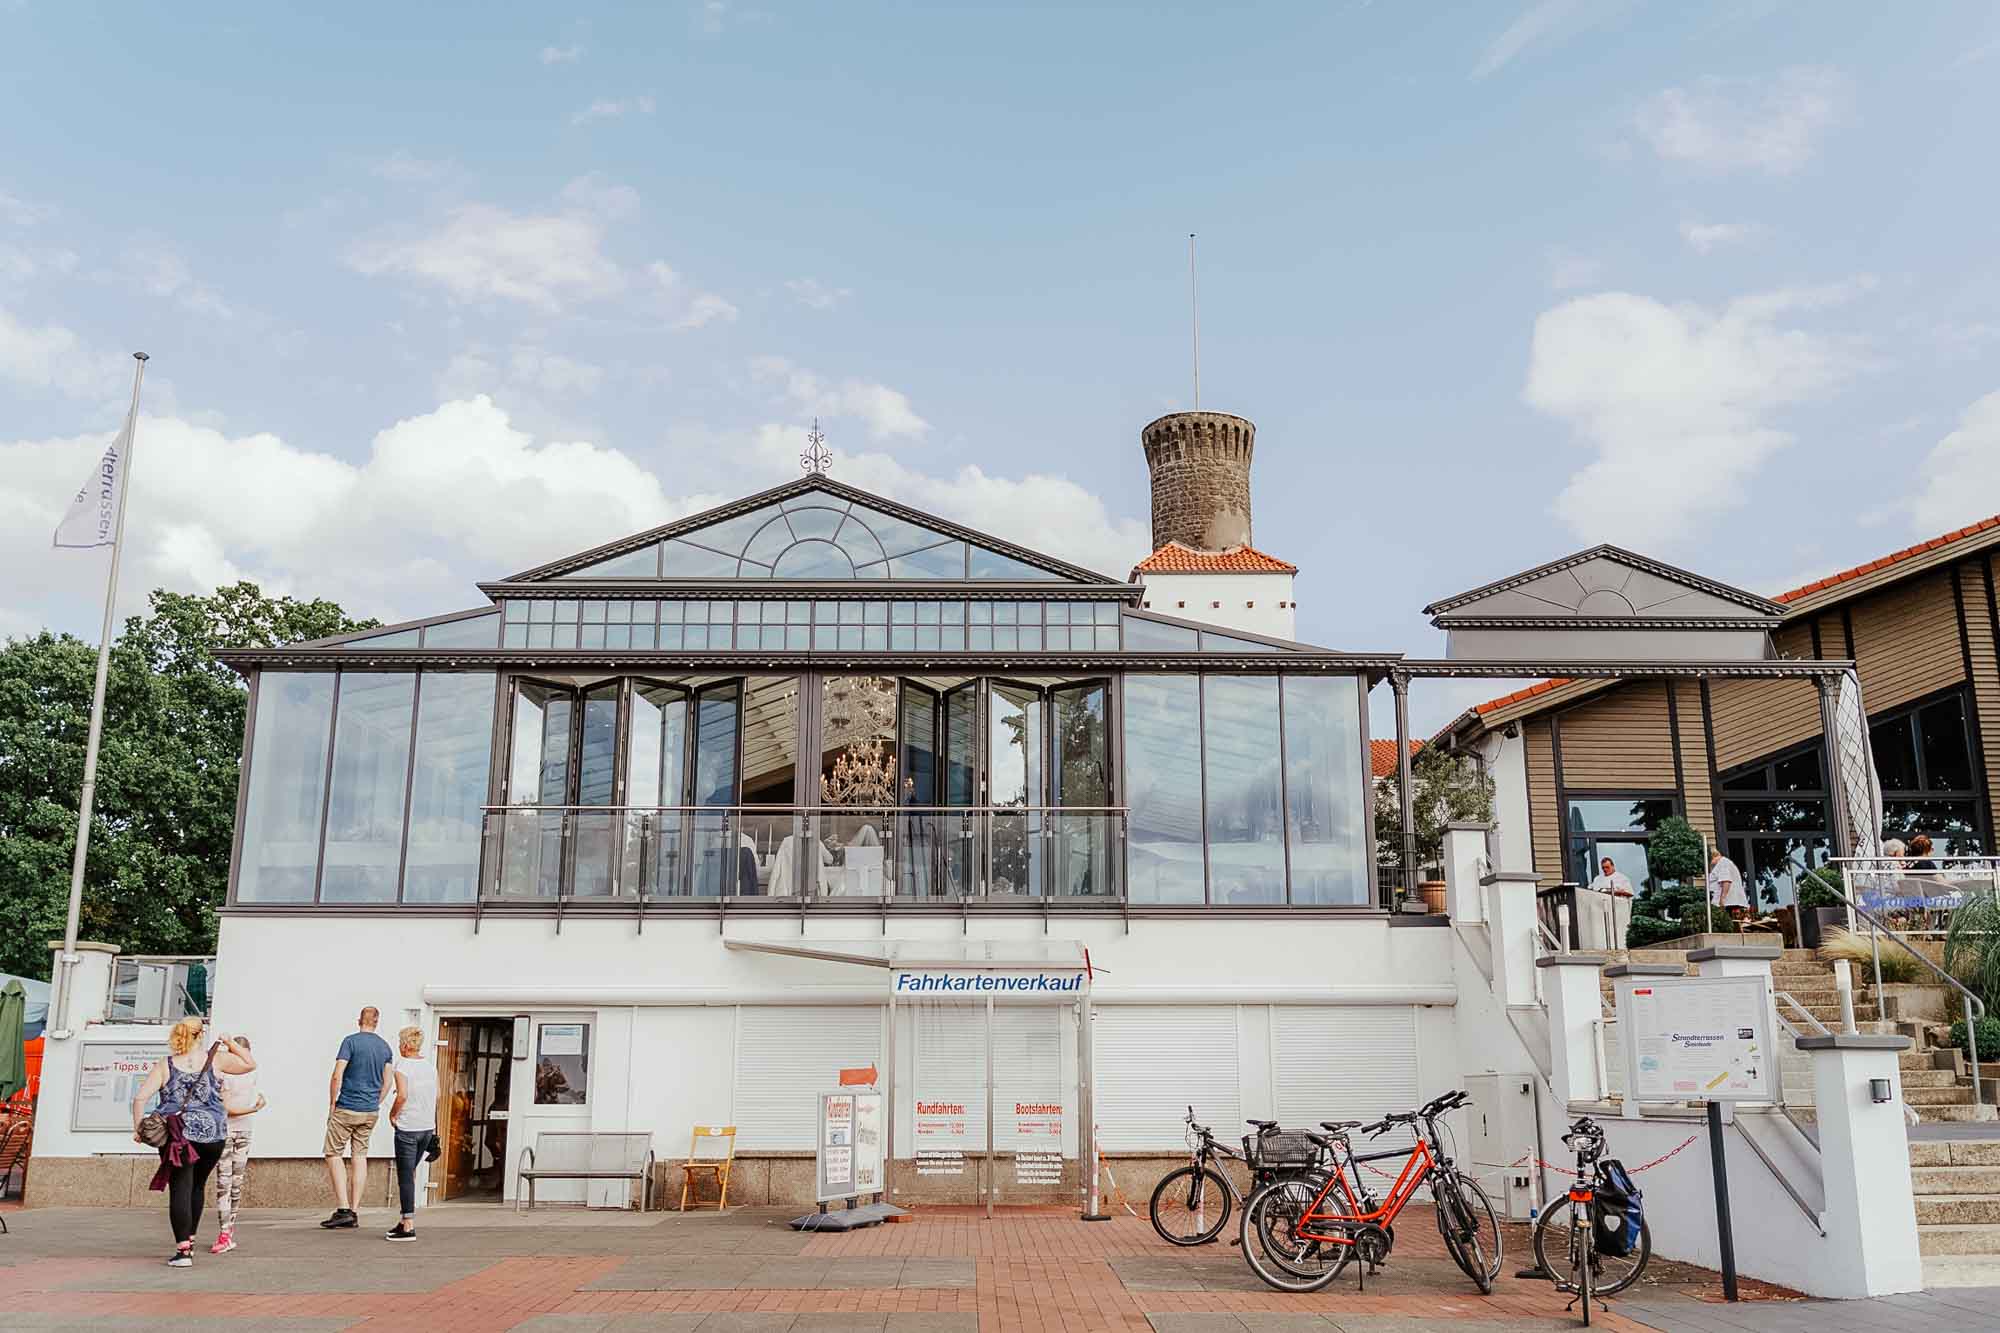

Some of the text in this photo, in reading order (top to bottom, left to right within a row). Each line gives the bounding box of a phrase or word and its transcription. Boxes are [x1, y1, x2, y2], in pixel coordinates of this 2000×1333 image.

[897, 973, 1084, 991] Fahrkartenverkauf
[113, 1062, 139, 1073] Tipps
[141, 1062, 149, 1072] &
[917, 1102, 965, 1115] Rundfahrten:
[1016, 1103, 1063, 1115] Bootsfahrten:
